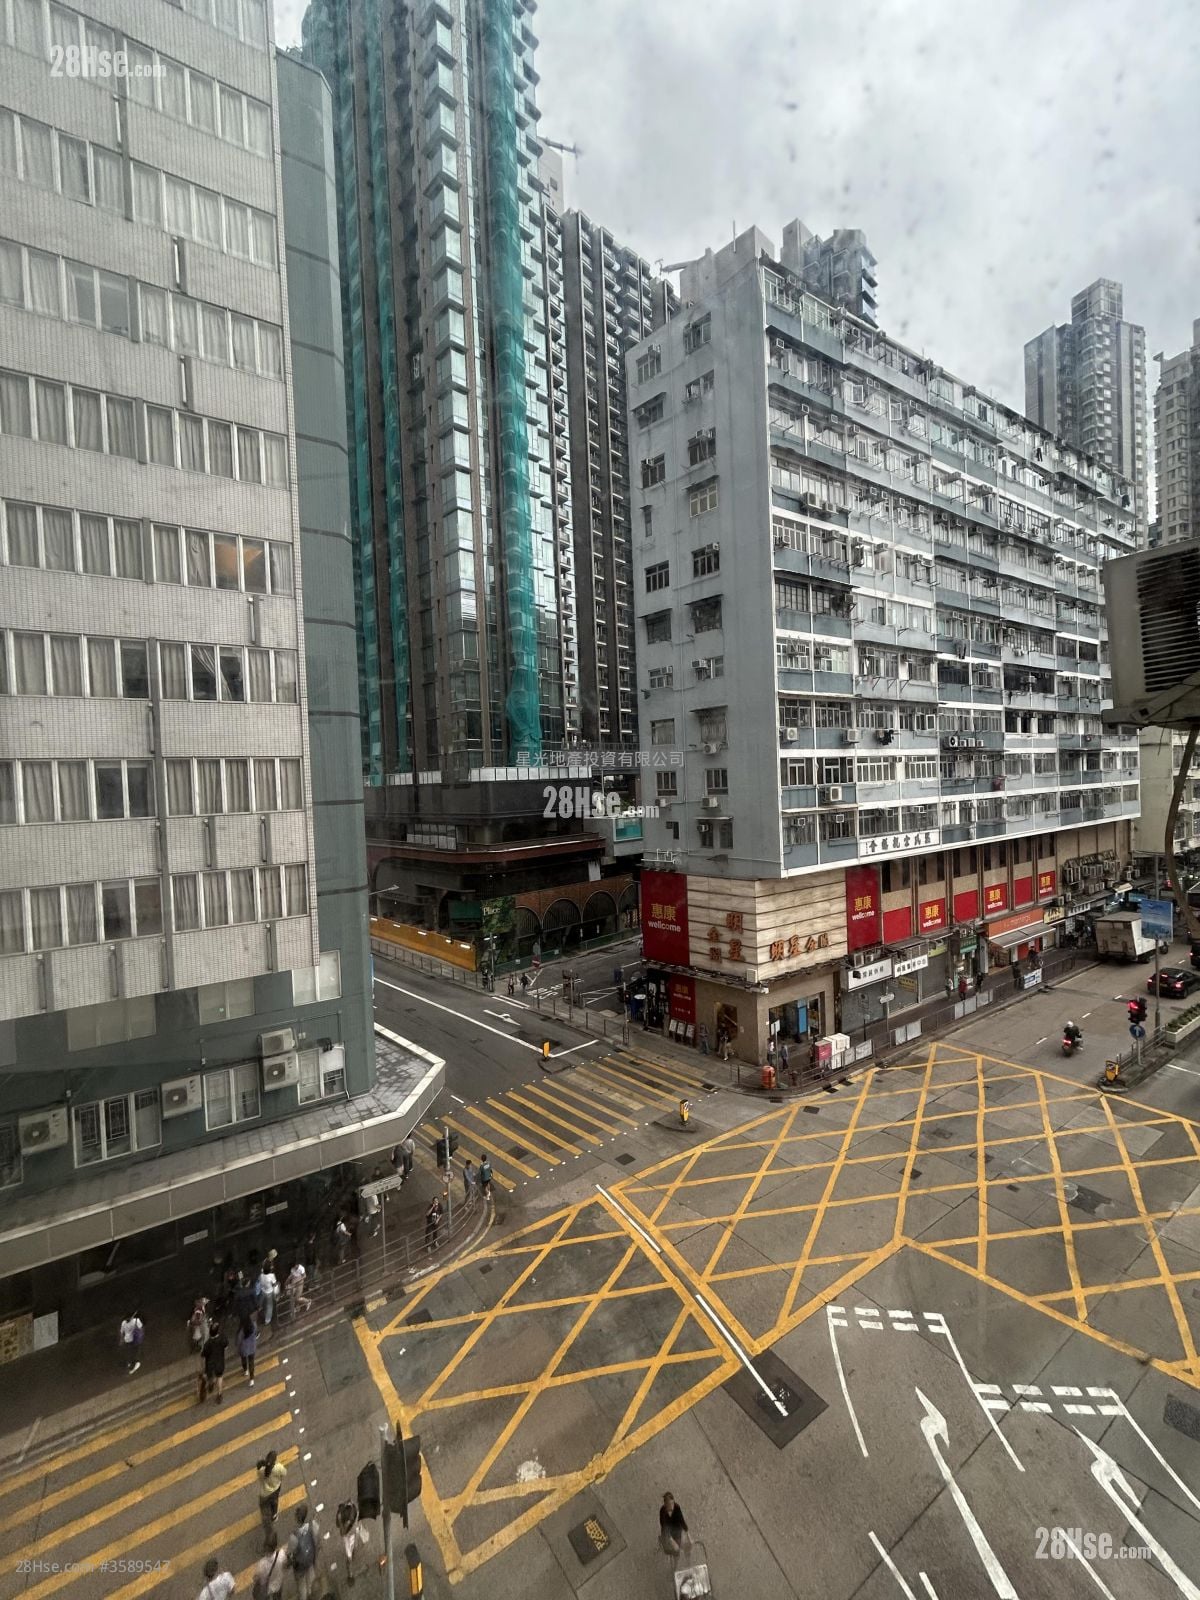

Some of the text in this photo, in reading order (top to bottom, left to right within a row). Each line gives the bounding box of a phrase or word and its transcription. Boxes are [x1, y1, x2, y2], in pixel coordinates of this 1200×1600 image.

[854, 895, 872, 911] 惠康
[651, 903, 676, 921] 惠康
[851, 910, 875, 921] wellcome
[925, 905, 939, 918] 惠康
[648, 920, 681, 933] wellcome
[922, 918, 942, 928] wellcome
